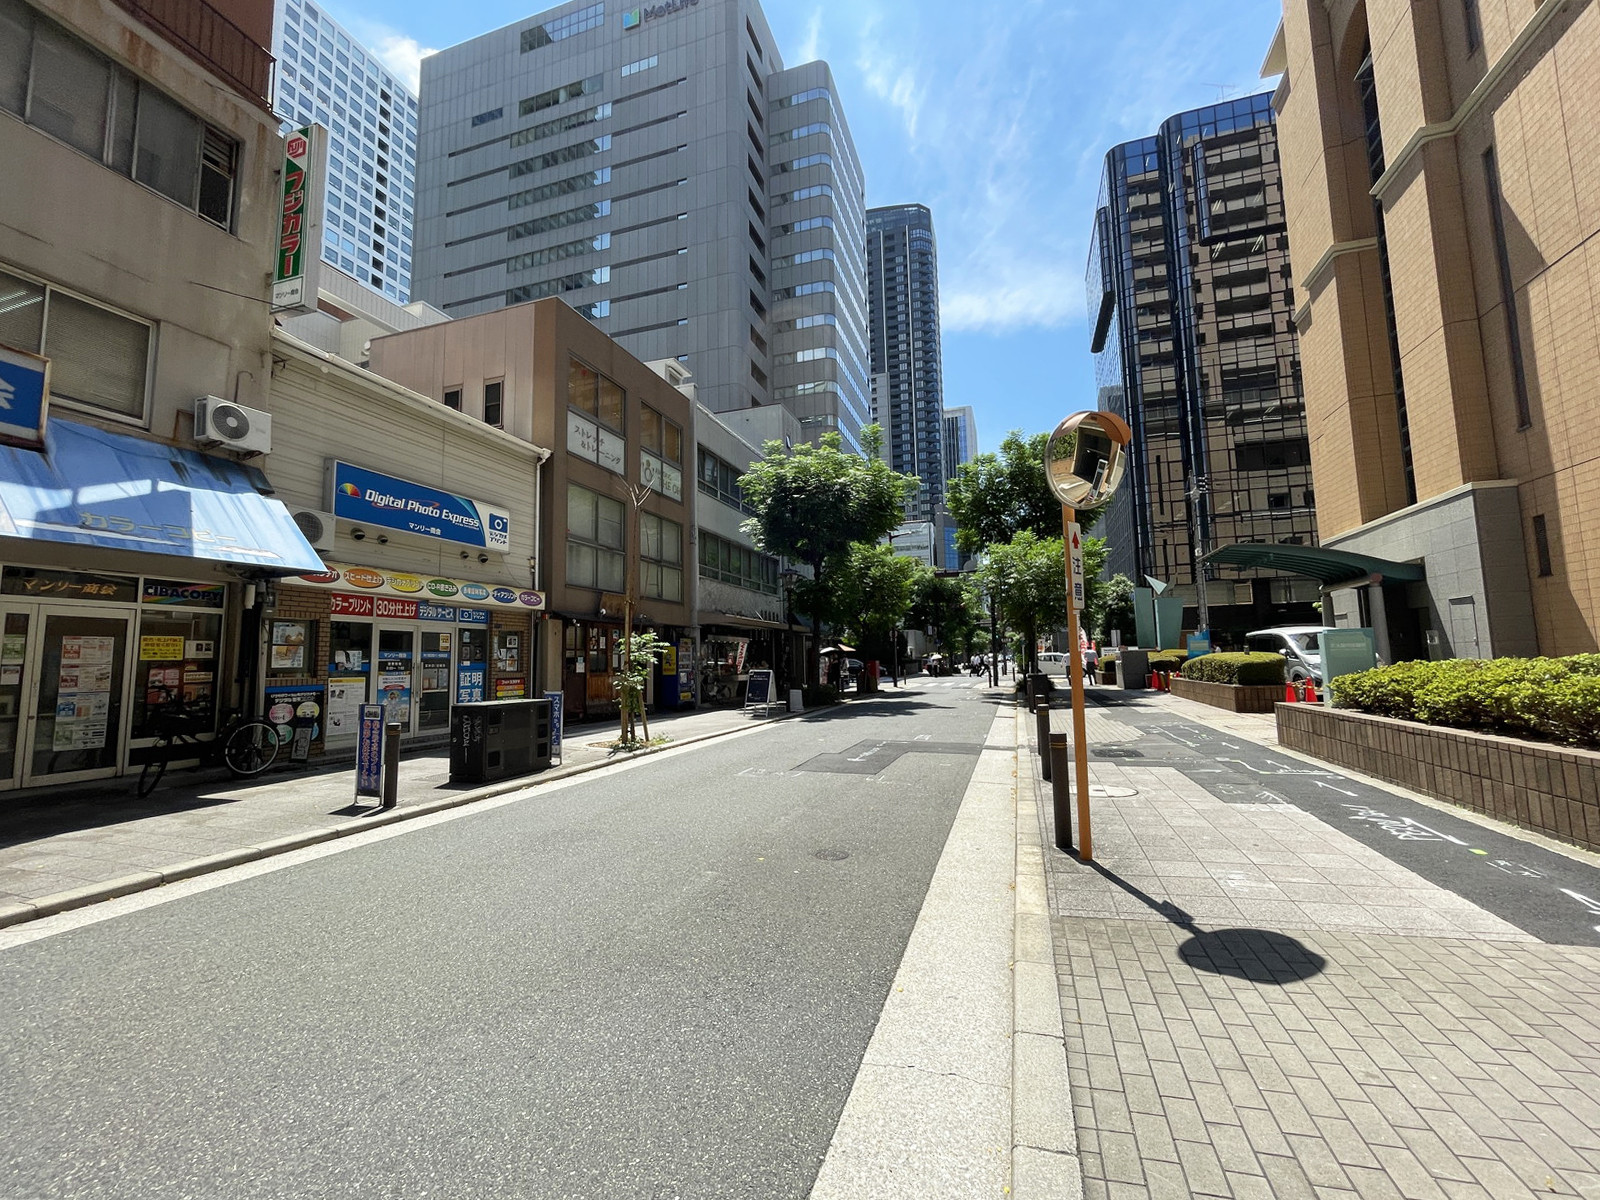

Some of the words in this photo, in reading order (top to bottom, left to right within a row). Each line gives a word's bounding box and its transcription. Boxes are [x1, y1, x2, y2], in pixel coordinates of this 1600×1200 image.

[281, 172, 305, 277] フジカラー
[574, 425, 605, 446] ストレッチ
[365, 488, 406, 508] Digital
[406, 500, 440, 518] Photo
[441, 509, 480, 528] Express
[24, 576, 118, 597] マンリー商会
[1072, 556, 1083, 601] 注意
[144, 584, 223, 601] CIBACOPY
[331, 597, 372, 614] カラープリント
[376, 600, 417, 617] 30分仕上げ
[419, 605, 437, 617] デジタル
[437, 607, 454, 619] サービス
[460, 672, 483, 687] 証明
[459, 688, 483, 703] 写真
